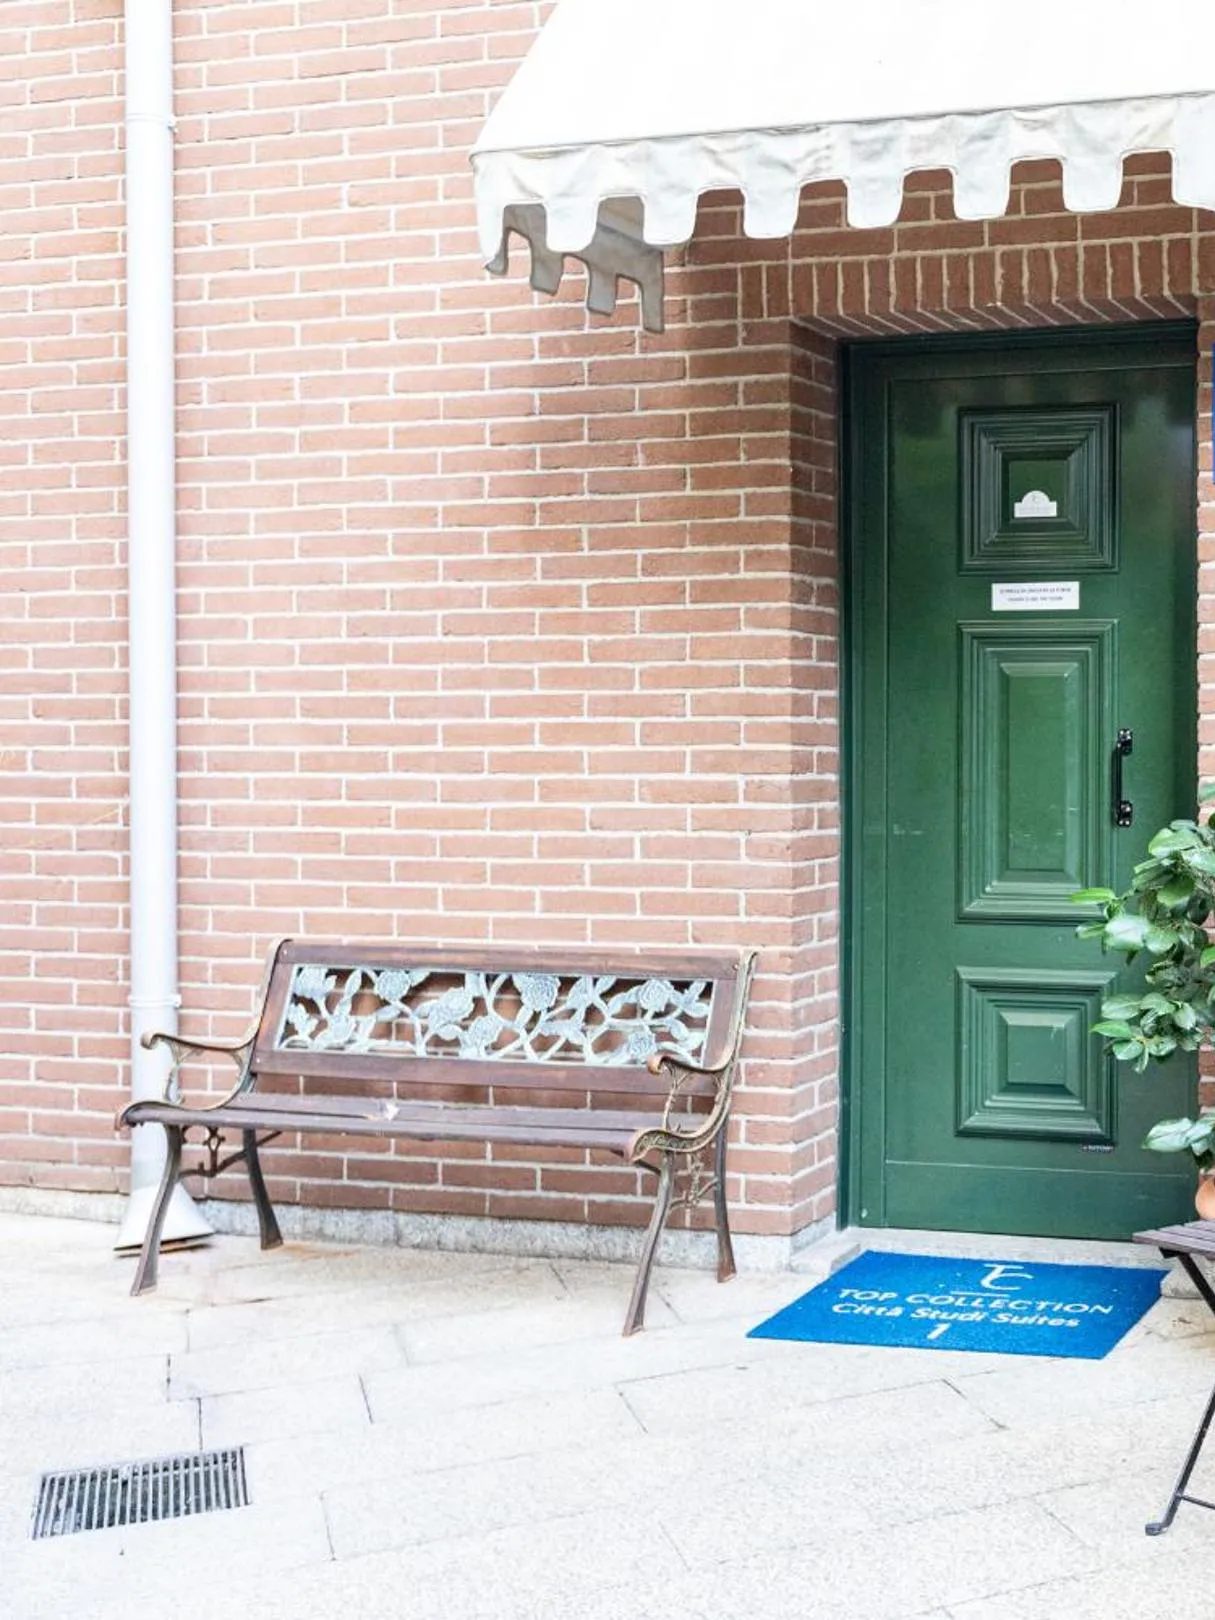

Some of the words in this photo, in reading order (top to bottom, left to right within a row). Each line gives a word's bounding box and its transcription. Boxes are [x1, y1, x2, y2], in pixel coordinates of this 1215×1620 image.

[839, 1288, 898, 1301] TOP
[906, 1293, 1114, 1315] COLLECTION
[832, 1303, 904, 1317] Città
[910, 1307, 988, 1322] Studi
[991, 1313, 1081, 1328] Suites
[927, 1322, 952, 1340] 1
